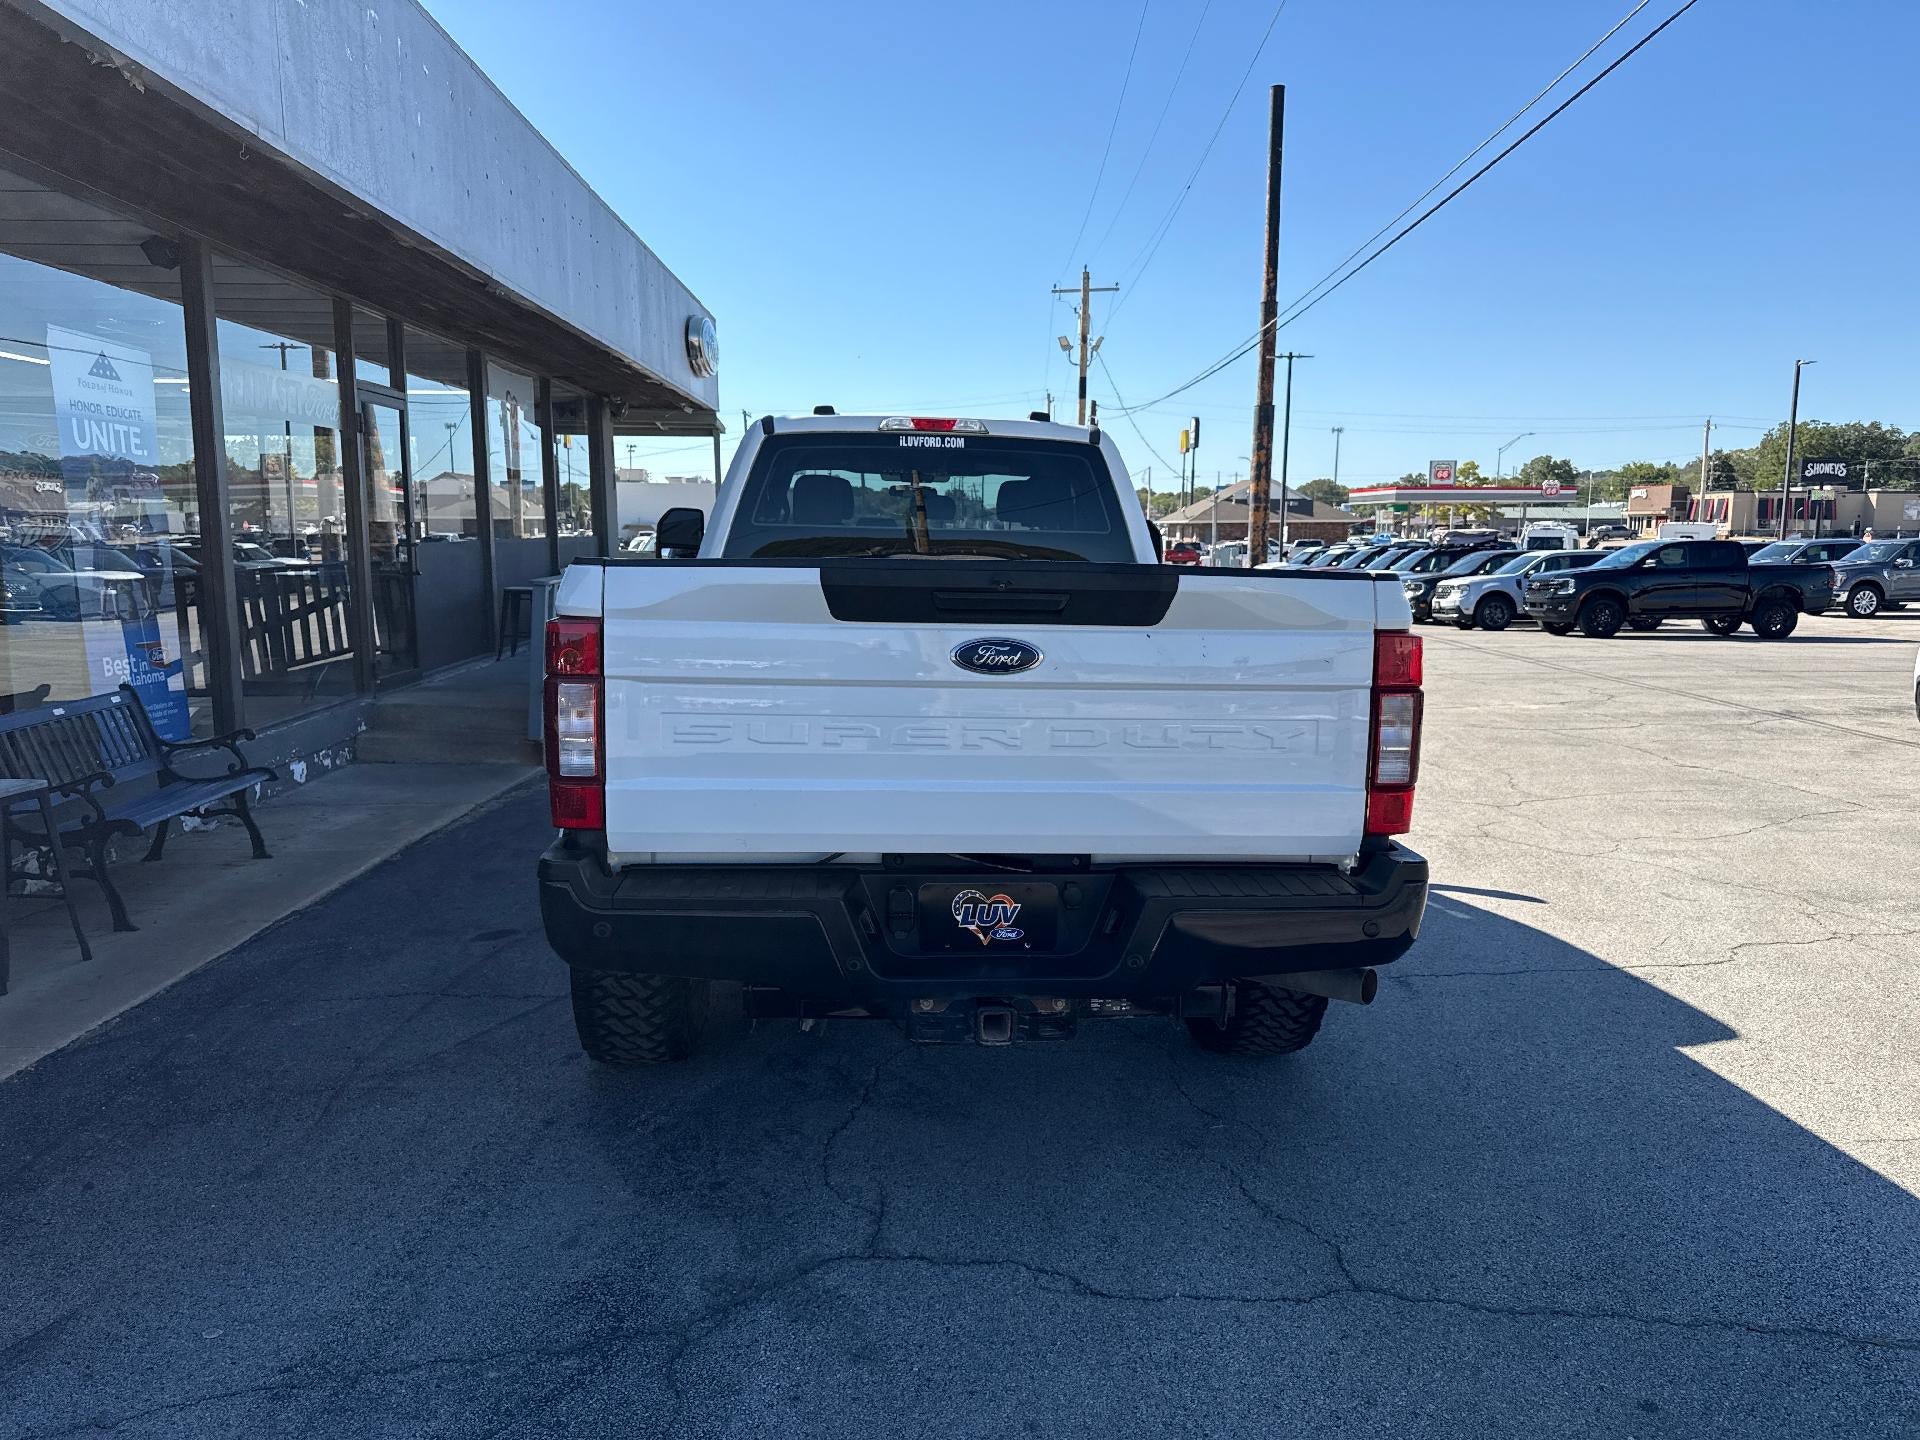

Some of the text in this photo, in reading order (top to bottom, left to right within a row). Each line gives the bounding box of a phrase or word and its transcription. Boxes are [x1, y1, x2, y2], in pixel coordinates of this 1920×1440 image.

[69, 399, 144, 421] HONOR. EDUCATE.
[71, 417, 148, 457] UNITE.
[900, 435, 965, 449] iLUVFORD.COM
[102, 654, 149, 678] Best in
[973, 645, 1021, 666] Ford
[672, 720, 1306, 751] SUPER DUTY
[959, 904, 1022, 928] LUV
[996, 929, 1019, 938] Ford
